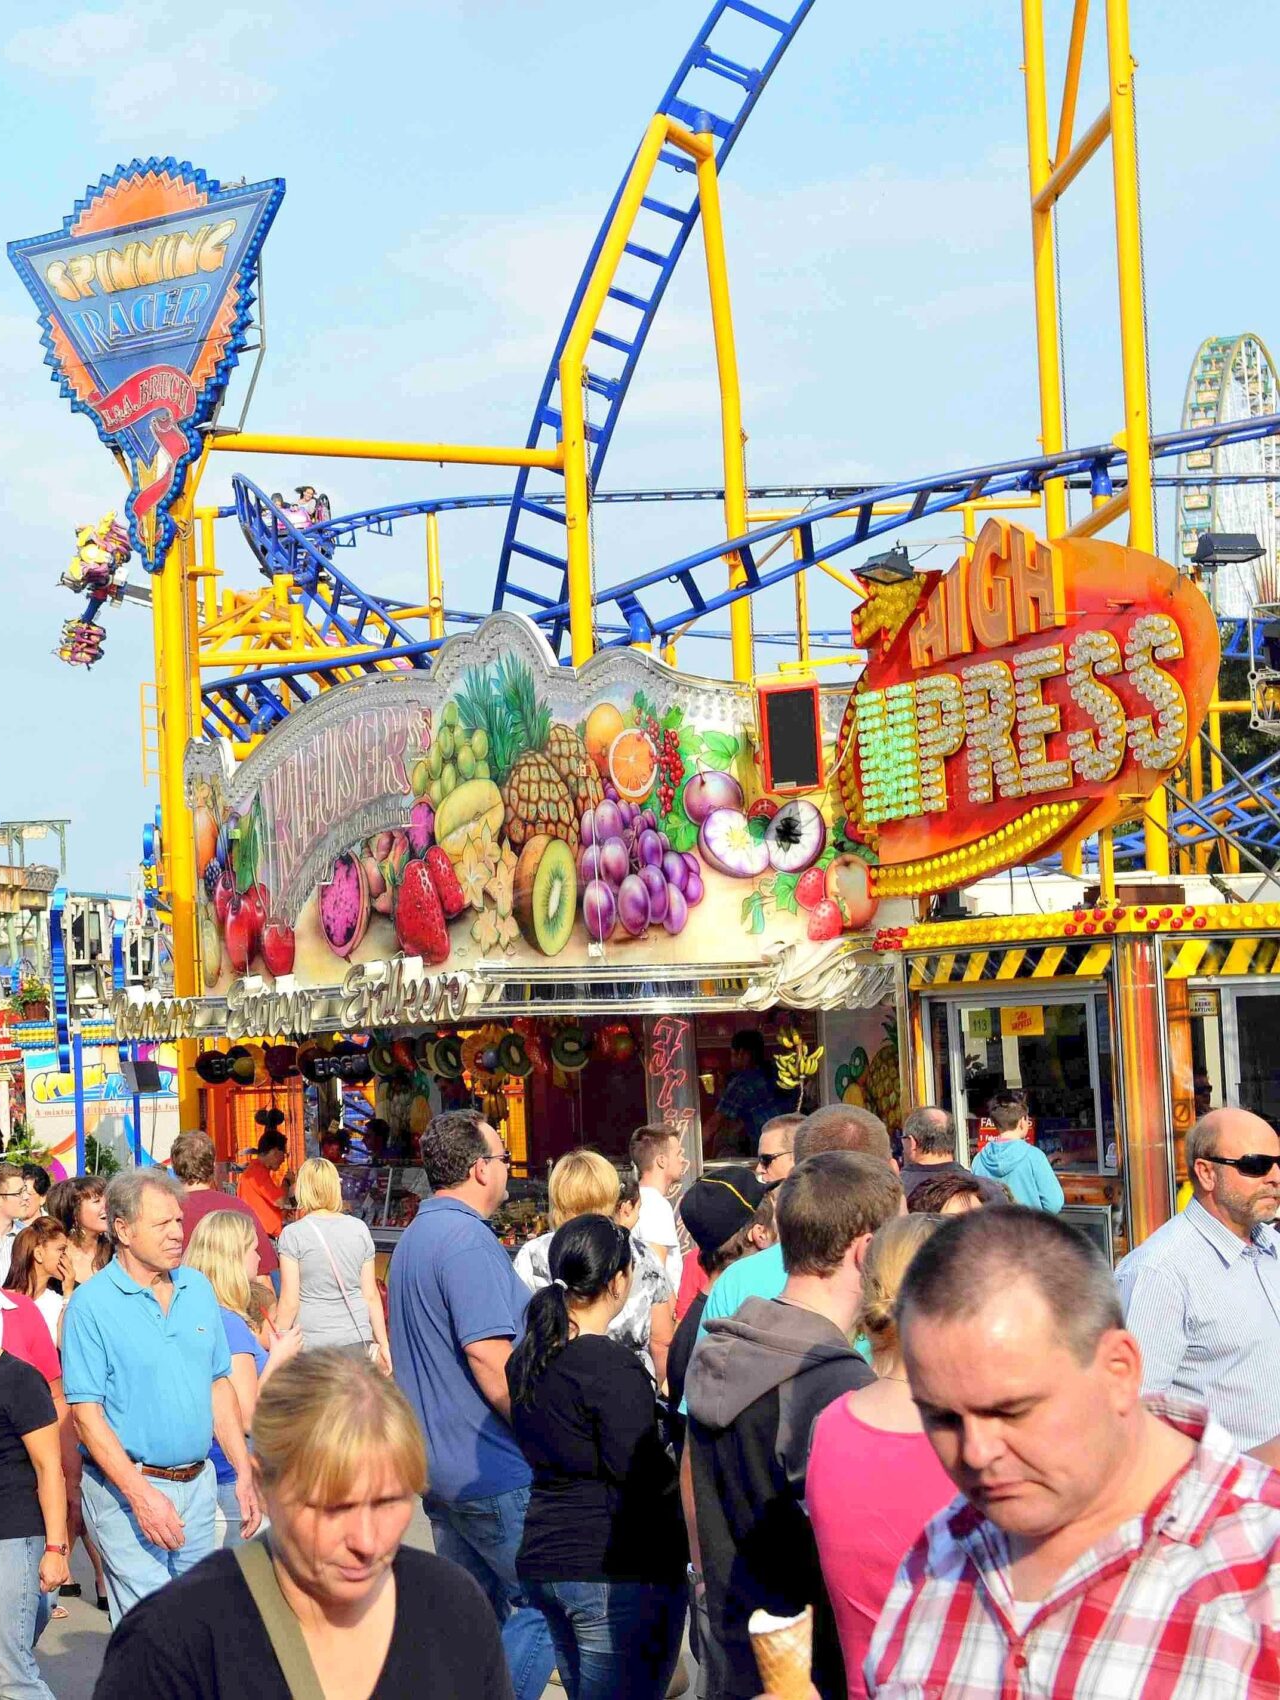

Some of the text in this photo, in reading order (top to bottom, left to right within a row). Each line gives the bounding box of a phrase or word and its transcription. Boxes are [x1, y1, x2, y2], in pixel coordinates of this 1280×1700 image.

[45, 218, 239, 302] SPINNING
[68, 282, 210, 355] RACER
[909, 517, 1066, 670] HIGH
[973, 1019, 987, 1031] 113
